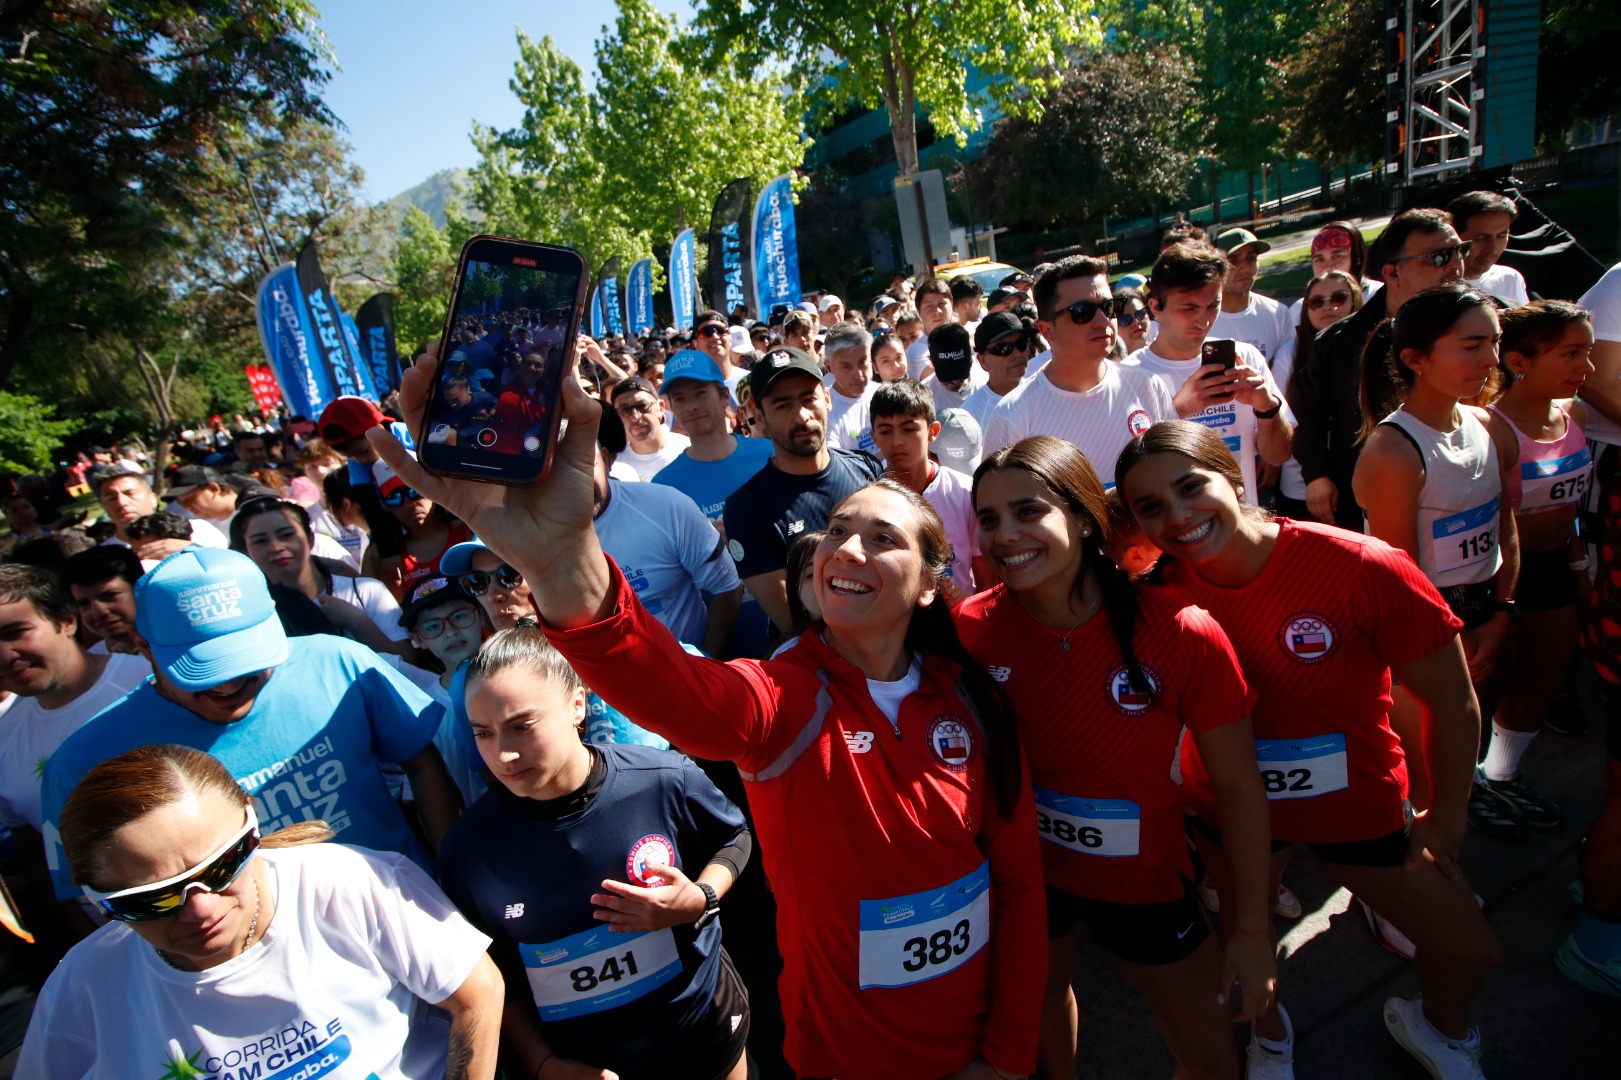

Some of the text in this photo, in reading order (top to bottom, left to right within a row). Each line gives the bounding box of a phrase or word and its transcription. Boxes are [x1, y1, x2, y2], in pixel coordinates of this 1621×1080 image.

[721, 221, 745, 315] SPARTA
[769, 191, 790, 298] Huechuraba.
[680, 239, 692, 317] Huechuraba.
[604, 276, 624, 335] SPARTA
[273, 284, 322, 406] Huechuraba.
[308, 287, 358, 396] SPARTA
[1206, 404, 1236, 416] CHILE
[1550, 473, 1585, 500] 675
[176, 586, 244, 612] santa
[177, 578, 239, 600] juanmanuel
[625, 568, 644, 581] ILE
[187, 600, 241, 623] cruz
[236, 735, 334, 791] nmanuel
[1260, 768, 1314, 793] 82
[254, 759, 348, 825] nta
[569, 950, 639, 993] 841
[902, 918, 970, 973] 383
[205, 1020, 318, 1074] CORRIDA
[265, 1017, 342, 1071] CHILE
